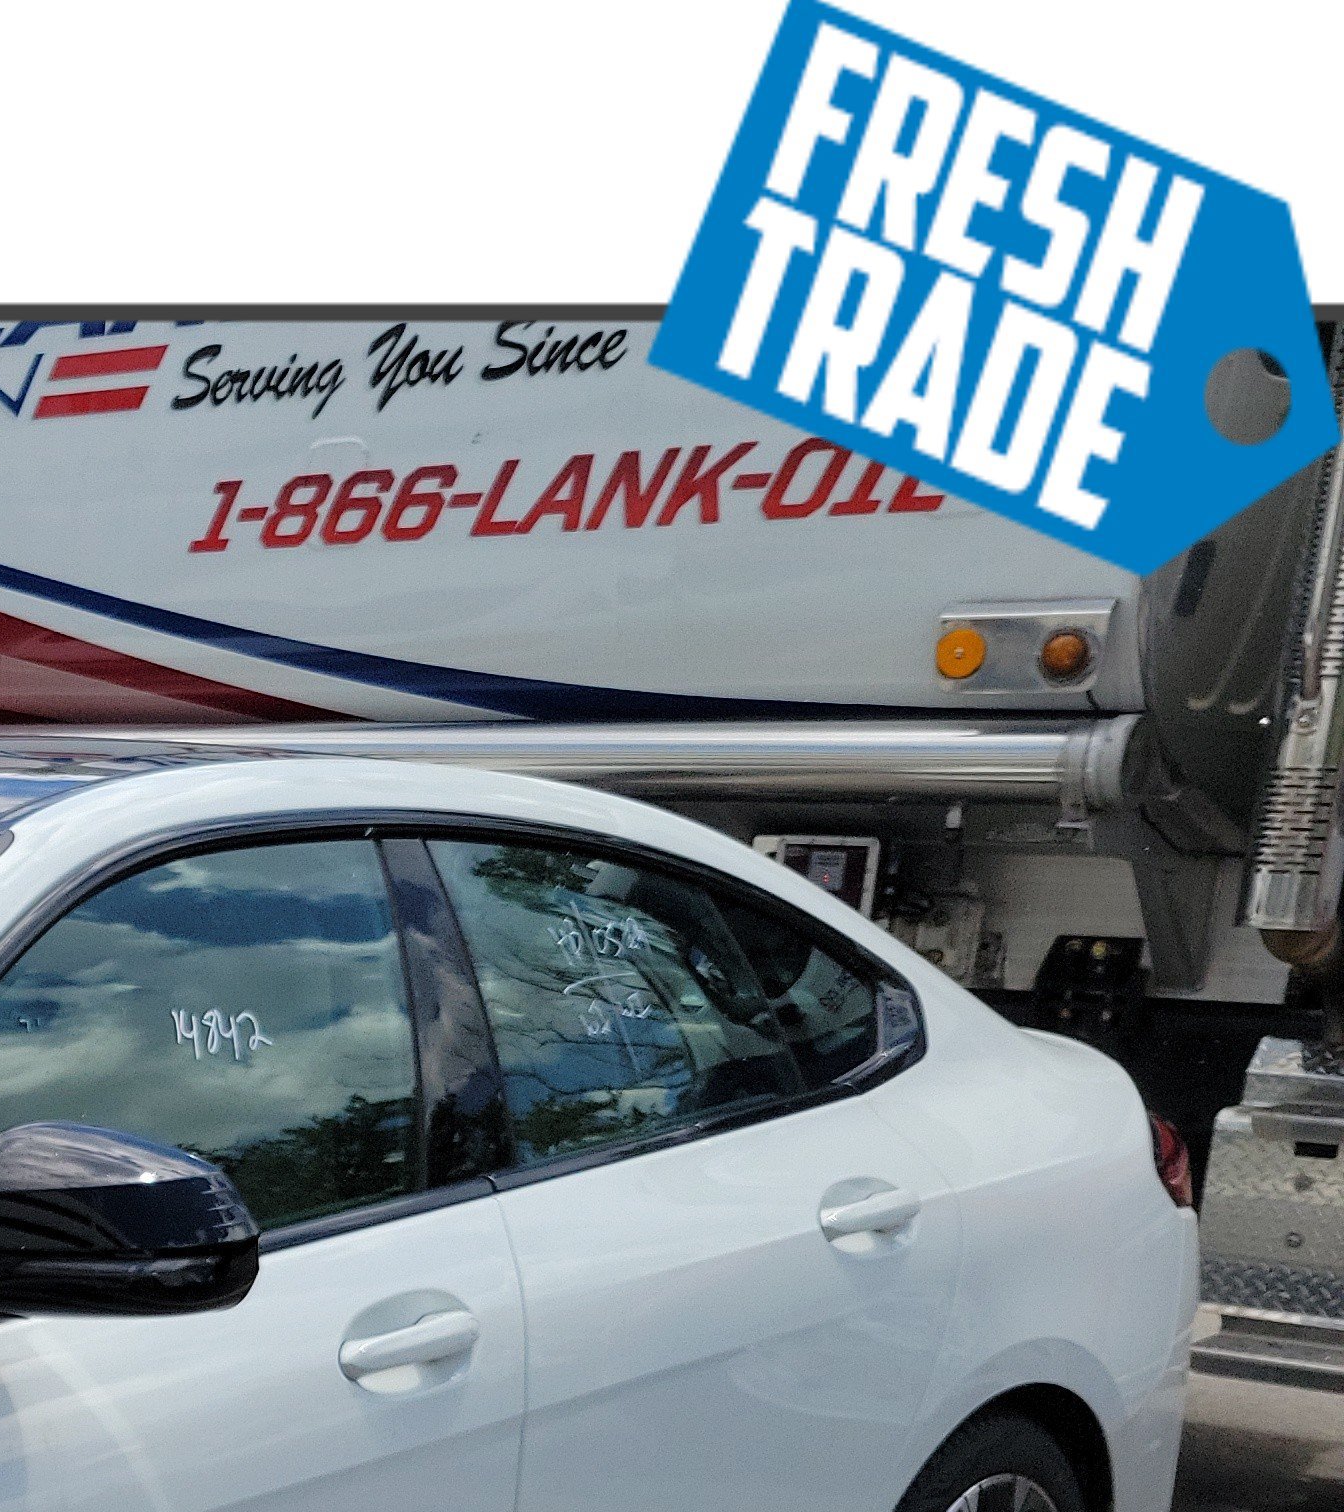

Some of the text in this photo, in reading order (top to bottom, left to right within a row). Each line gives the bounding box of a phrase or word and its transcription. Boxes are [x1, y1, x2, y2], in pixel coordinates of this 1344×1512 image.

[170, 320, 628, 419] Serving You Since
